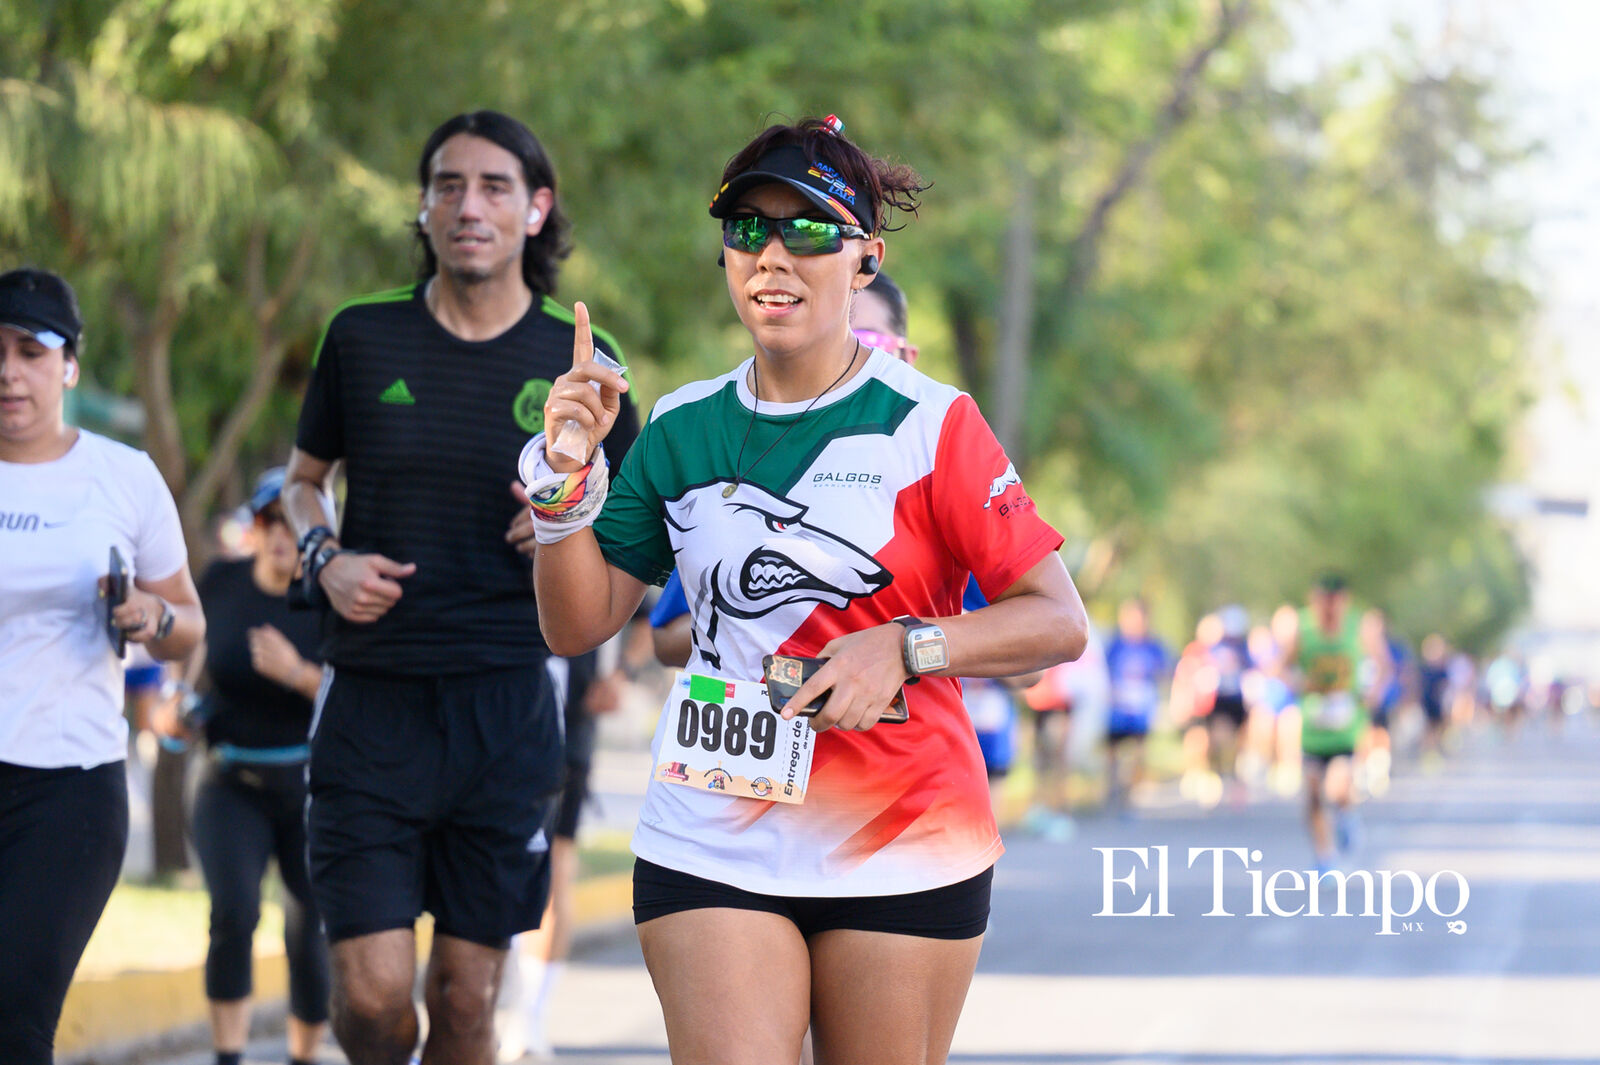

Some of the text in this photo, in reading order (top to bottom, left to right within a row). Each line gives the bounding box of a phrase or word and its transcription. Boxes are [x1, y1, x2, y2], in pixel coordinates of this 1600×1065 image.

[813, 472, 882, 484] GALGOS
[677, 699, 777, 760] 0989
[784, 720, 802, 796] Entrega de
